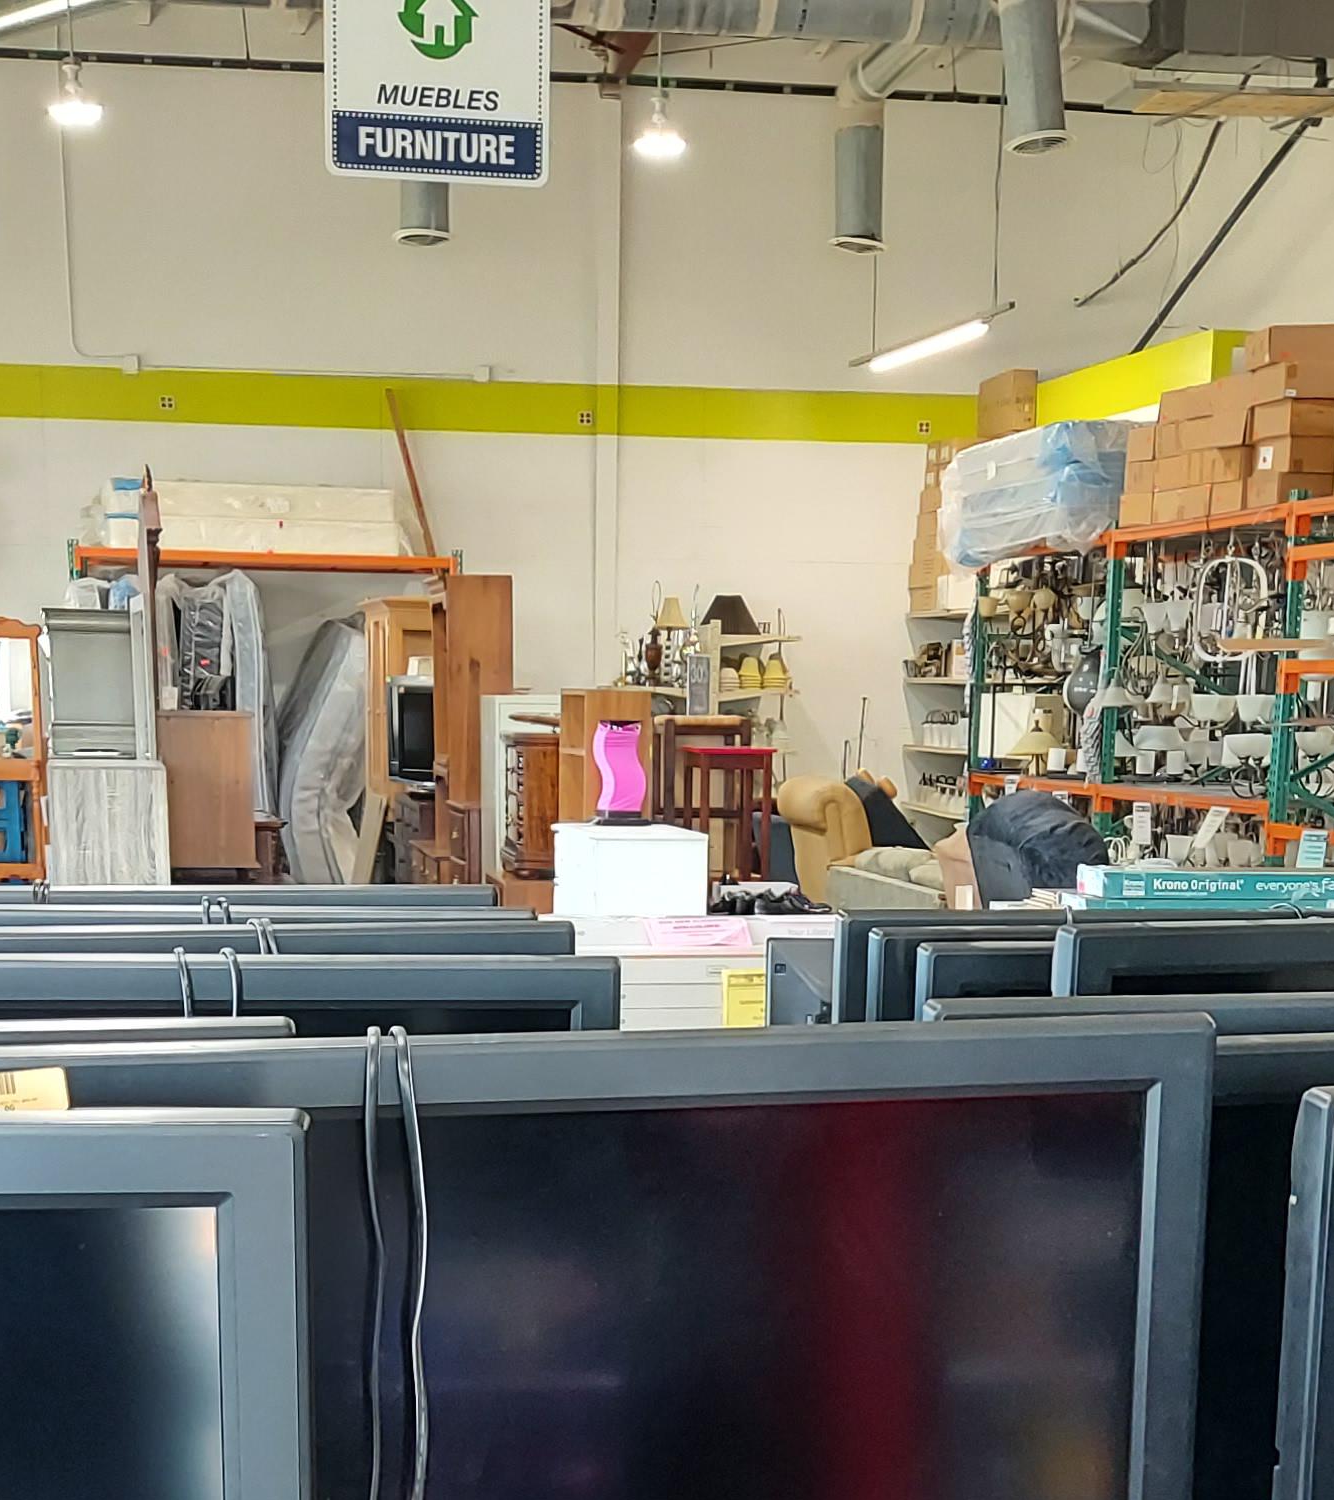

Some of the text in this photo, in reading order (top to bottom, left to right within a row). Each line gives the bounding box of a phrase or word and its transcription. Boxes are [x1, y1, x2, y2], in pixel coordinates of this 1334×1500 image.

[376, 83, 500, 112] MUEBLES
[357, 125, 516, 166] FURNITURE
[1153, 878, 1188, 890] Krono
